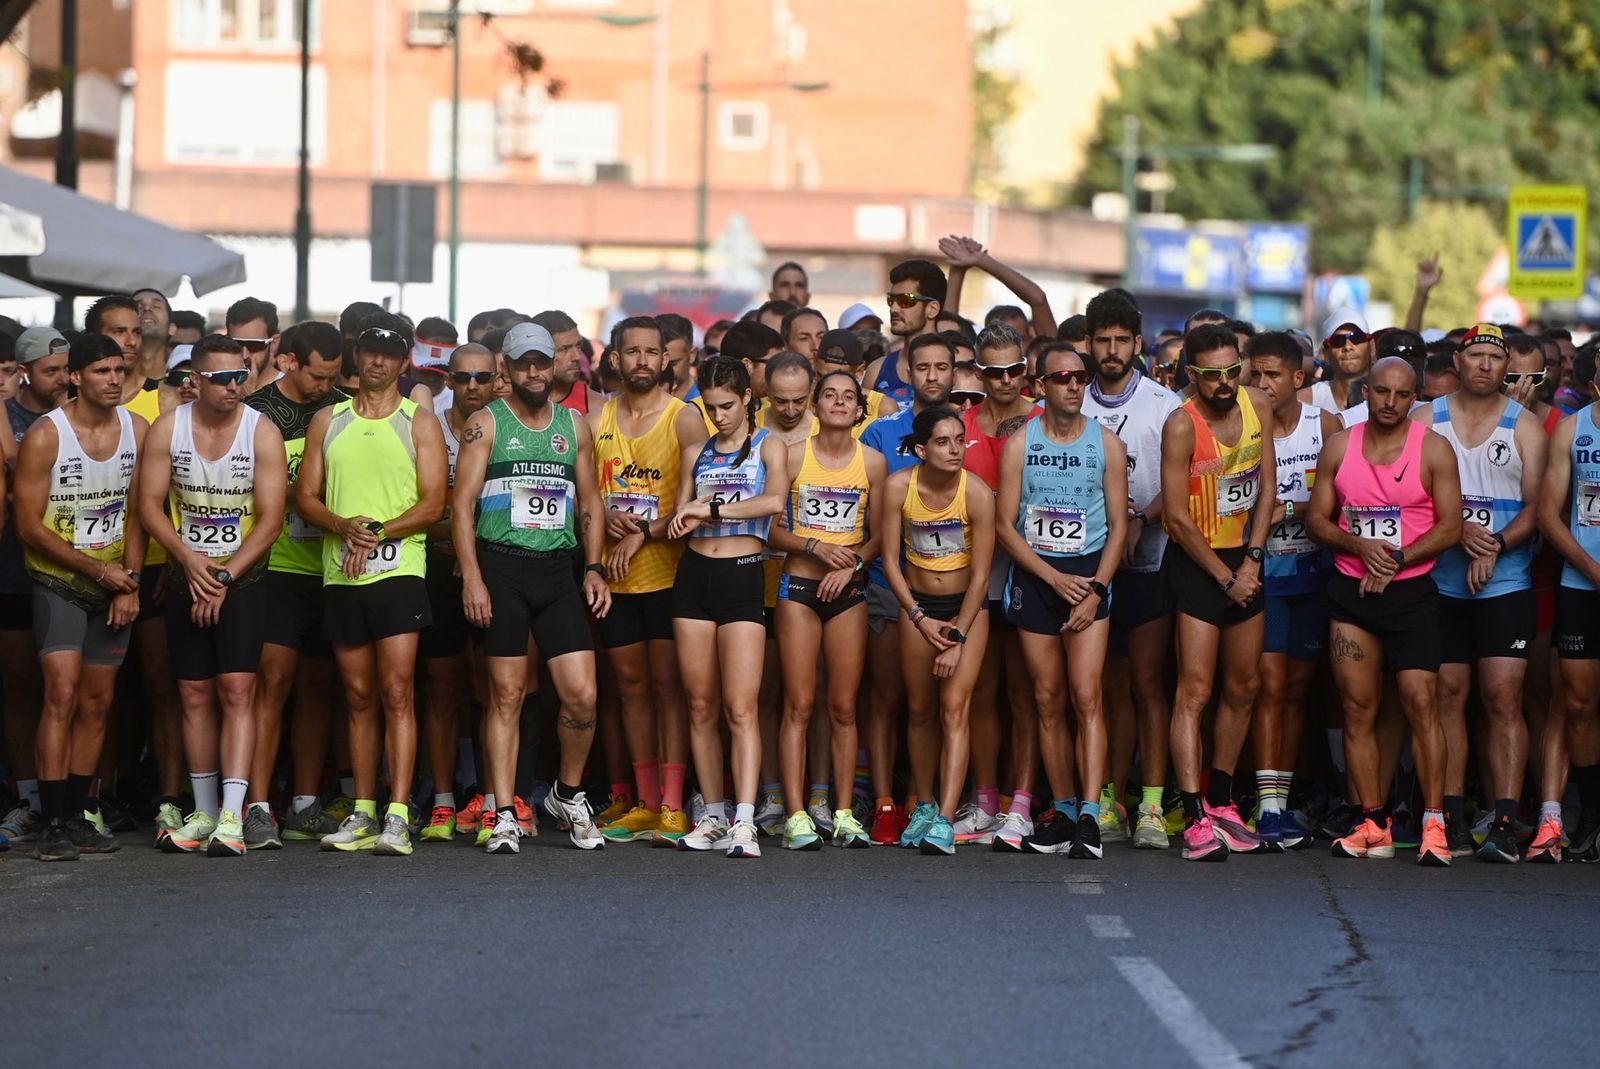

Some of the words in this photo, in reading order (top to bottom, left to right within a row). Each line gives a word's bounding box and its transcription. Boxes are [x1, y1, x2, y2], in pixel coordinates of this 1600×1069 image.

[1475, 335, 1504, 347] ESPAÑA
[512, 463, 565, 476] ATLETISMO
[1026, 452, 1081, 470] nerja
[621, 461, 662, 480] Álora
[77, 488, 111, 500] TRIATLÓN
[184, 484, 222, 495] TRIATLÓN
[528, 496, 557, 515] 96
[806, 498, 856, 518] 337
[188, 524, 237, 544] 528
[1033, 518, 1083, 539] 162
[1352, 518, 1398, 537] 513
[929, 531, 942, 546] 1
[737, 556, 757, 565] NIKE
